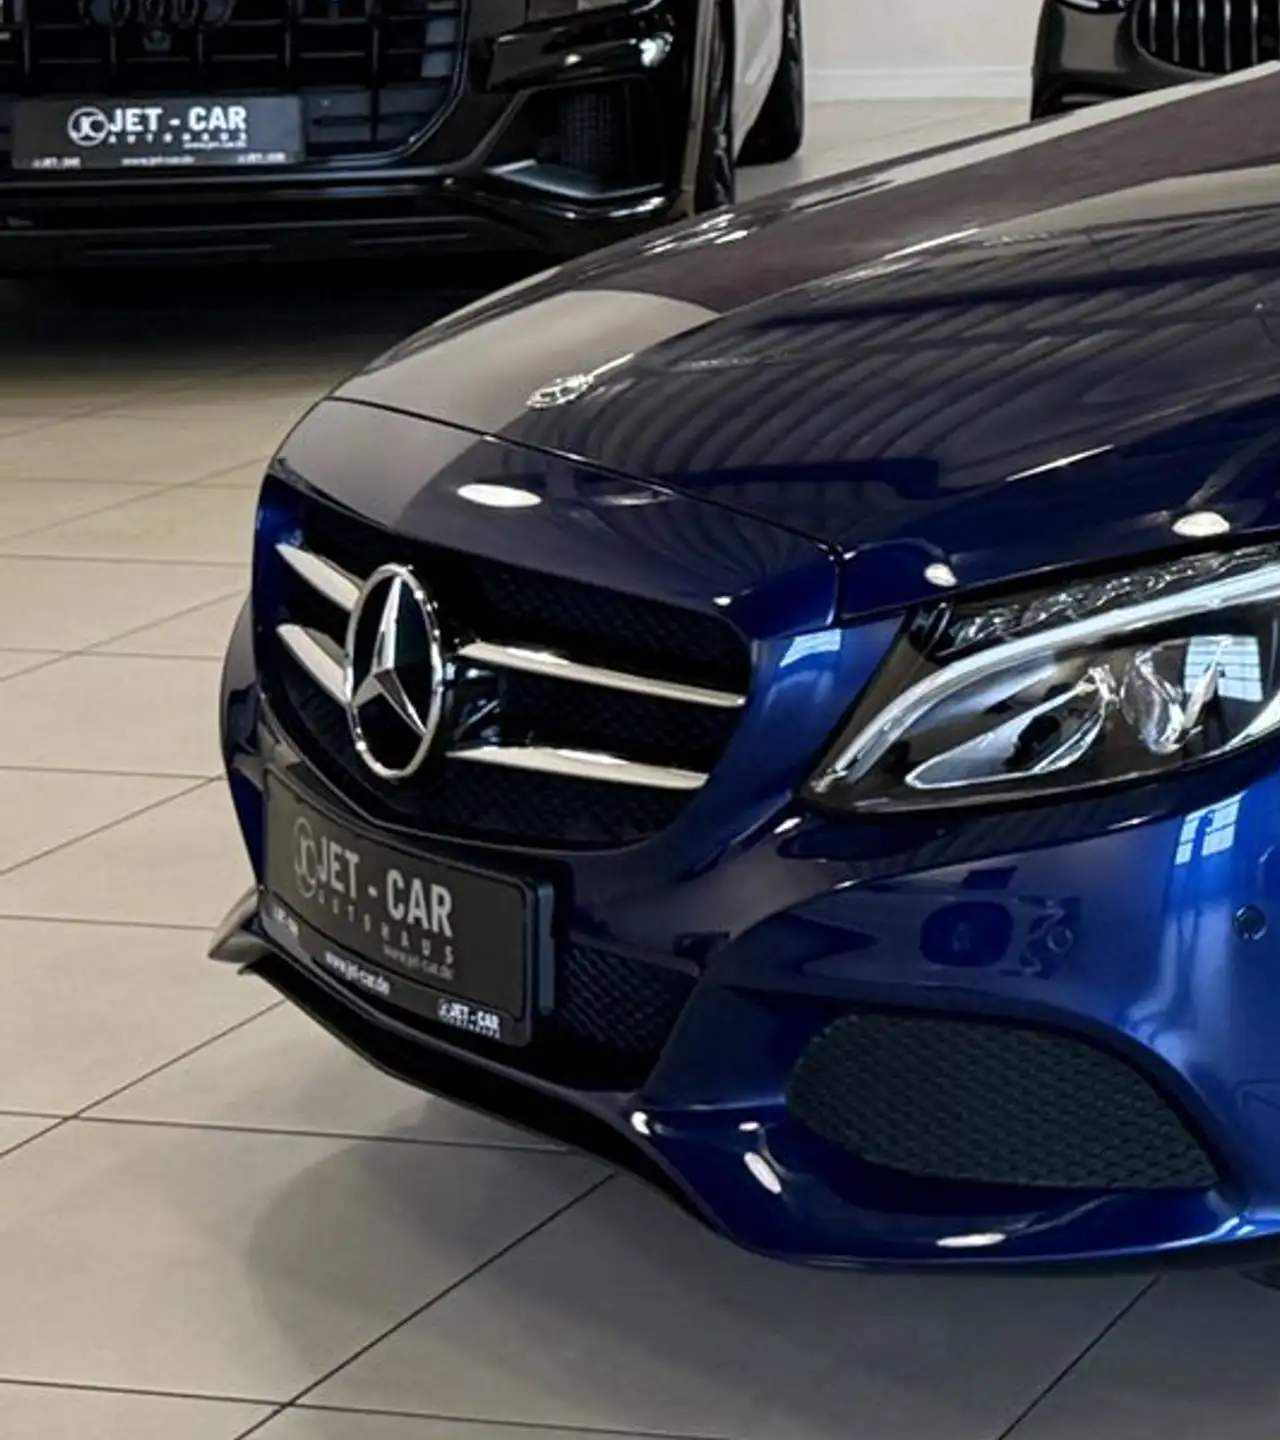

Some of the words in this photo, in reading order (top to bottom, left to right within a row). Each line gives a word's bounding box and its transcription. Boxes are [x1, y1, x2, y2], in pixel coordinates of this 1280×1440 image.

[109, 108, 163, 132] JET
[187, 106, 248, 131] CAR
[317, 835, 360, 899] JET
[386, 868, 453, 938] CAR
